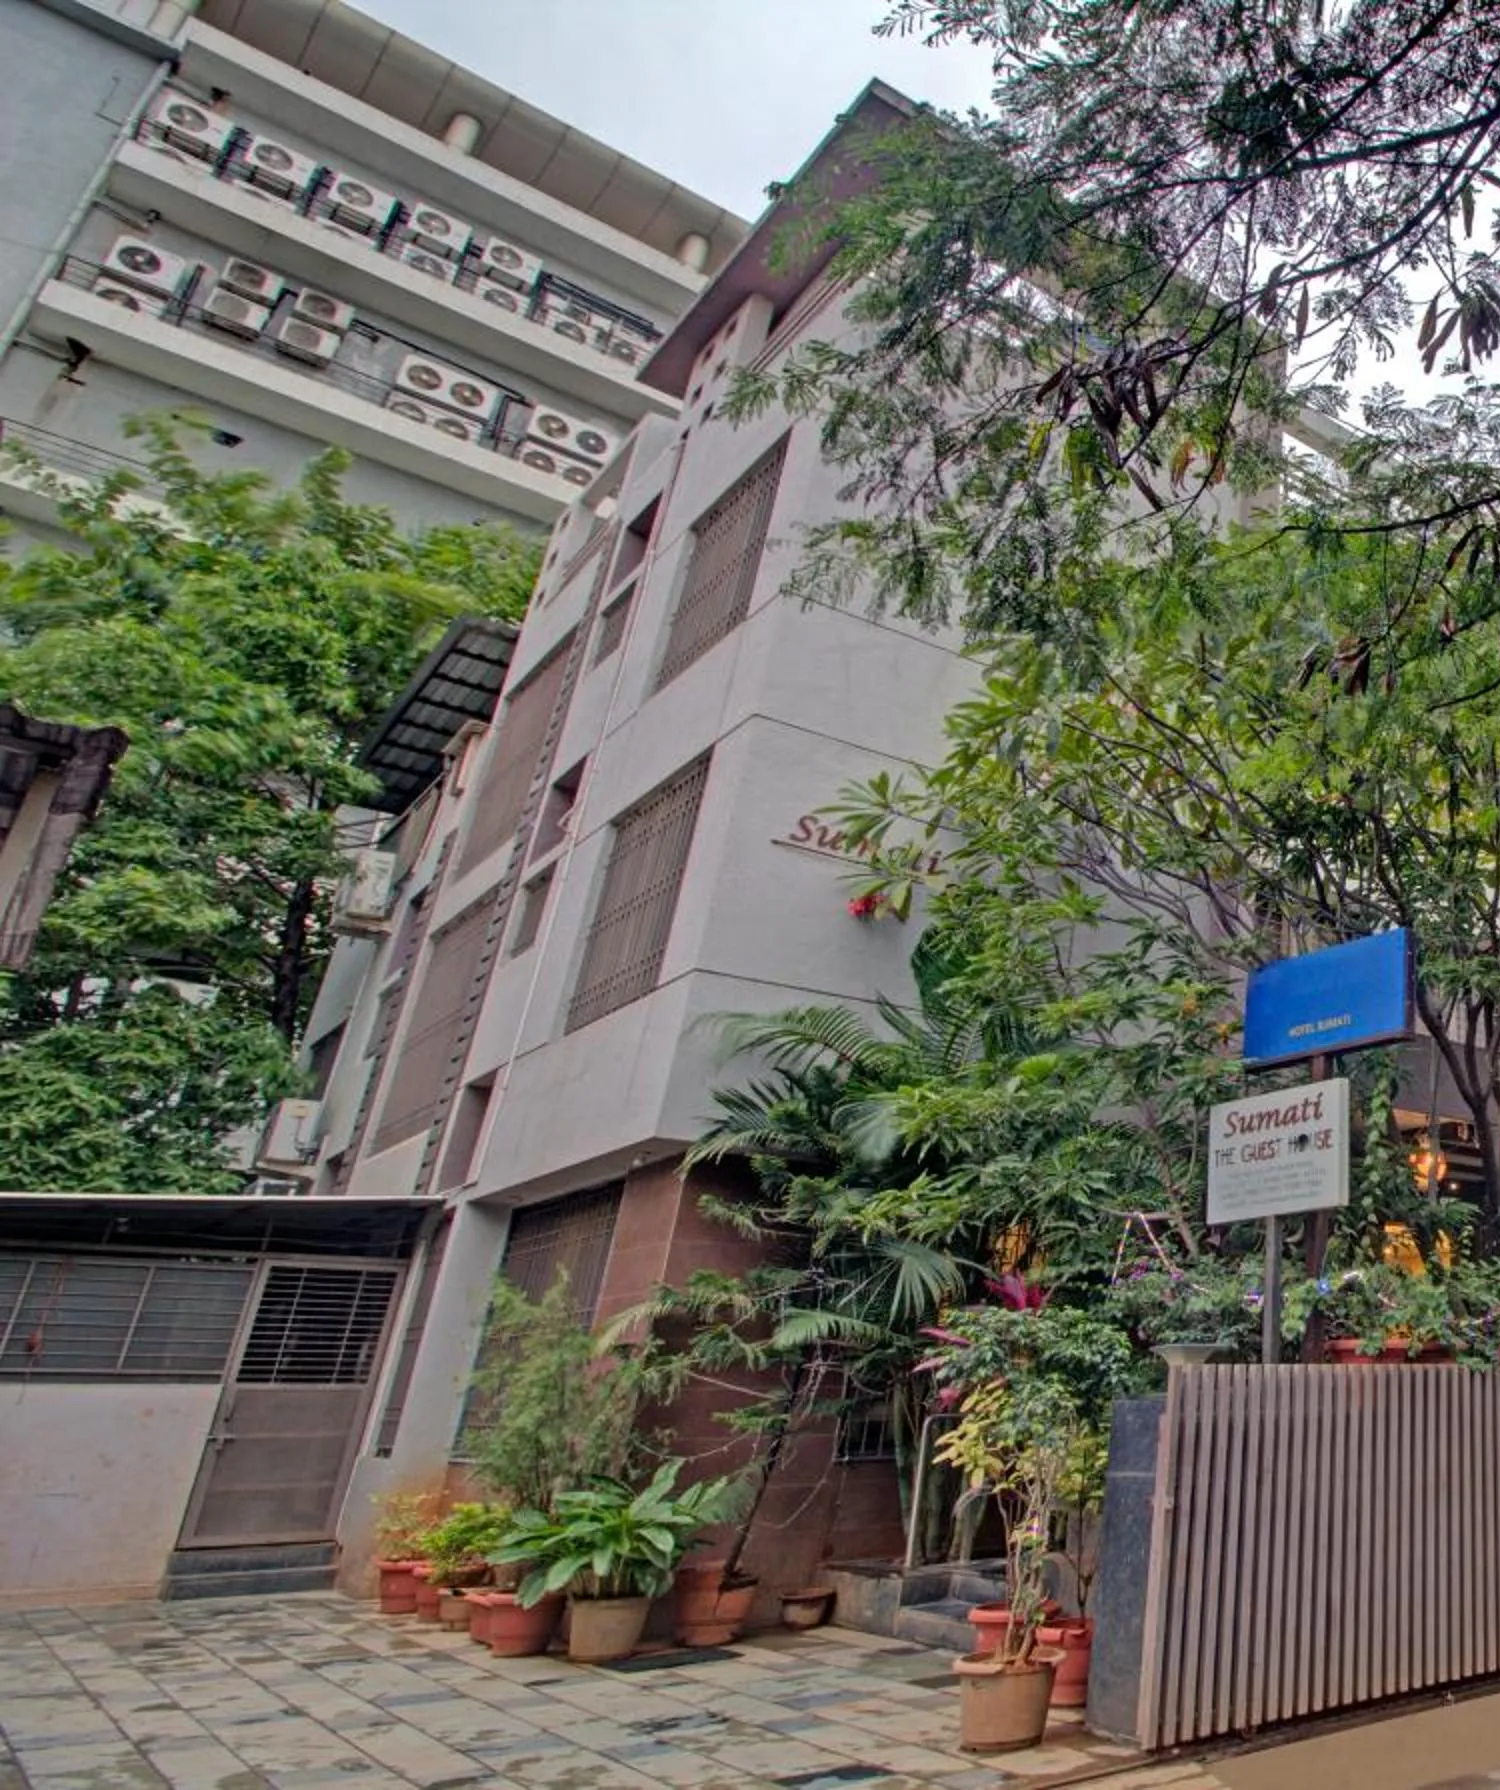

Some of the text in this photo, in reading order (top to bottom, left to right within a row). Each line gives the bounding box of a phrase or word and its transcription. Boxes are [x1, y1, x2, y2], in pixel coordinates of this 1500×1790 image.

[1224, 1092, 1323, 1138] Sumati
[1215, 1146, 1236, 1168] THE
[1241, 1137, 1283, 1163] GUEST
